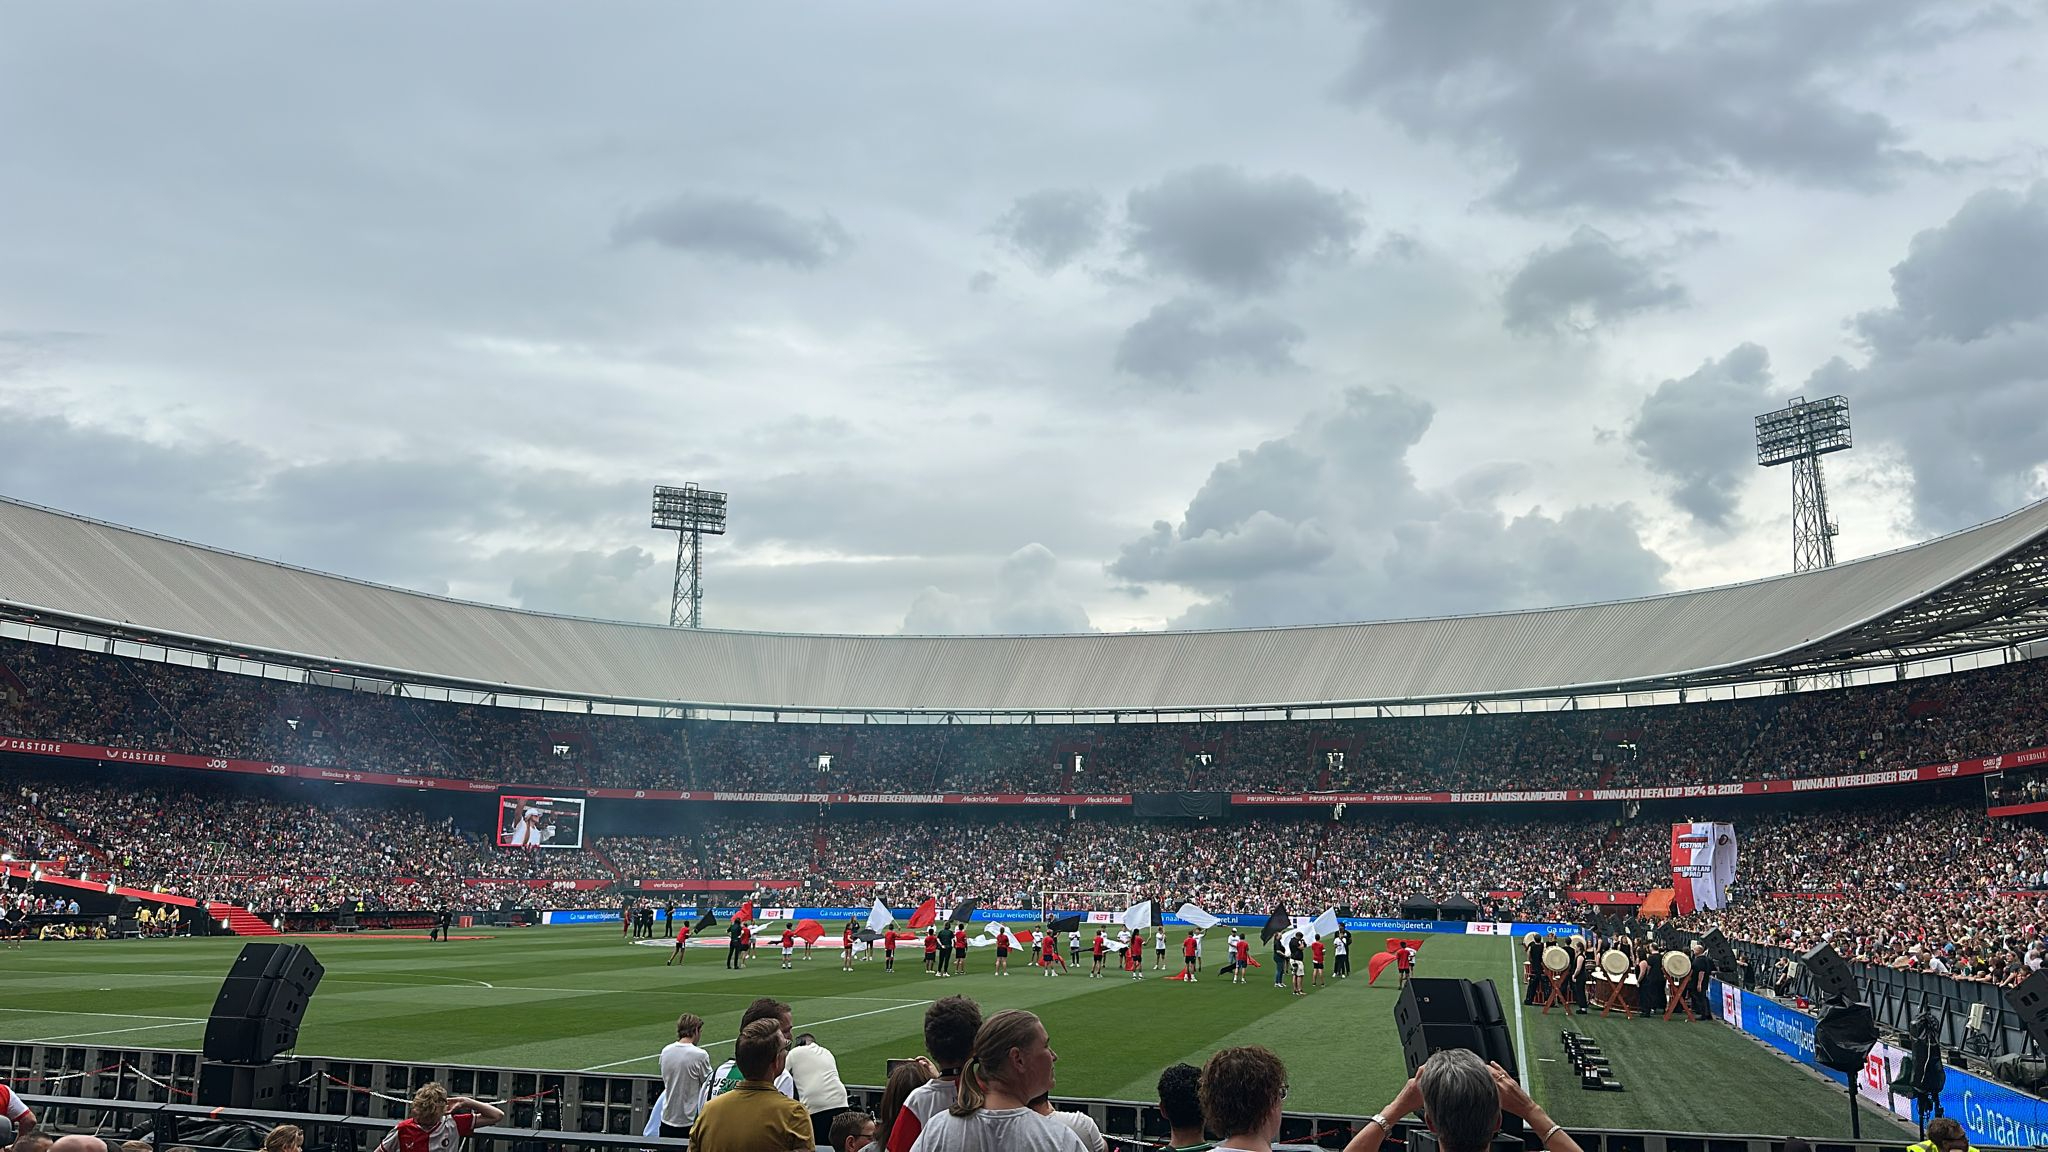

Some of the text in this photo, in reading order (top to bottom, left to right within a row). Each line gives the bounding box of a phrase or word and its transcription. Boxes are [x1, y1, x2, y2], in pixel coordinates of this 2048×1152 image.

[11, 740, 61, 753] CASTORE
[122, 751, 167, 763] CASTORE
[2017, 751, 2046, 763] RIVERDALE
[1792, 768, 1918, 791] WINNAAR WERELDBEKER 1970
[713, 792, 753, 801] WINNAAR
[808, 794, 829, 803] 1970
[1461, 792, 1485, 802] KEER
[1486, 790, 1567, 802] LANDSKAMPIOEN
[1592, 789, 1640, 800] WINNAAR
[1640, 788, 1664, 799] UEFA
[1666, 787, 1682, 798] CUP
[1684, 786, 1706, 797] 1974
[1718, 784, 1744, 795] 2002
[858, 794, 878, 802] KEER
[879, 794, 944, 803] BEKERWINNAAR
[1370, 921, 1433, 930] werkenbijderet.nl
[1546, 926, 1556, 934] Ga
[1558, 926, 1572, 934] naar
[1964, 1090, 1984, 1136] Ga
[1986, 1107, 2020, 1147] naar
